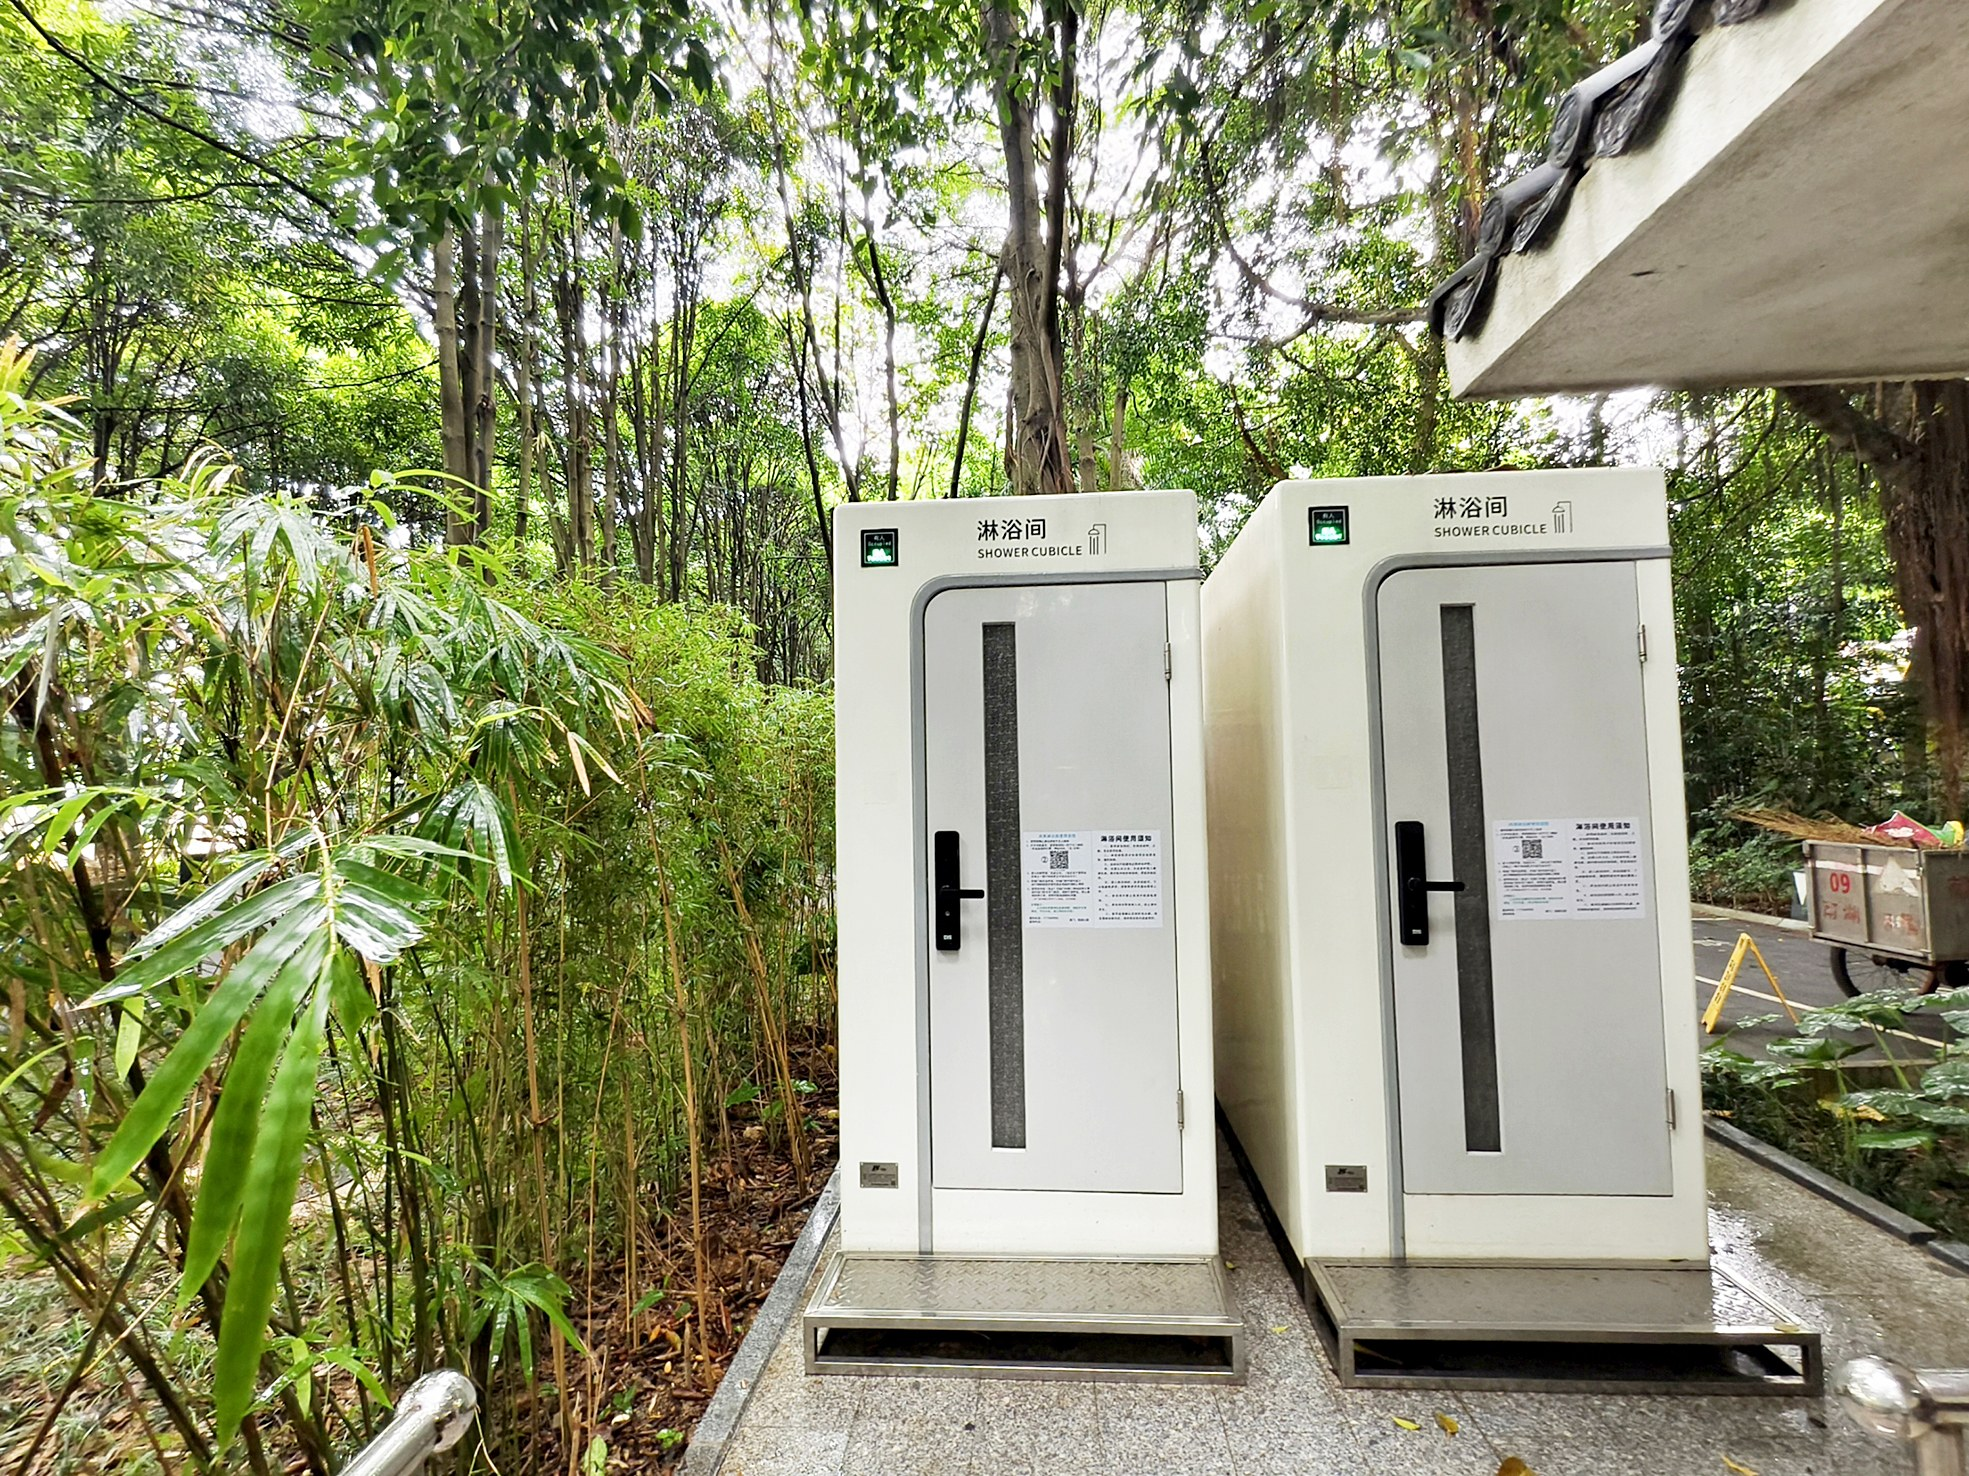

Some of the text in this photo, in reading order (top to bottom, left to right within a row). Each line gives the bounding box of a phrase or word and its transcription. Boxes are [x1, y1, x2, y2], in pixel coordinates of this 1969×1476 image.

[1433, 496, 1508, 519] 淋浴间
[977, 518, 1046, 541] 淋浴间
[1434, 523, 1548, 538] SHOWER CUBICLE
[977, 545, 1083, 559] SHOWER CUBICLE
[1575, 821, 1631, 830] 淋浴间使用须知
[1830, 872, 1851, 894] 09
